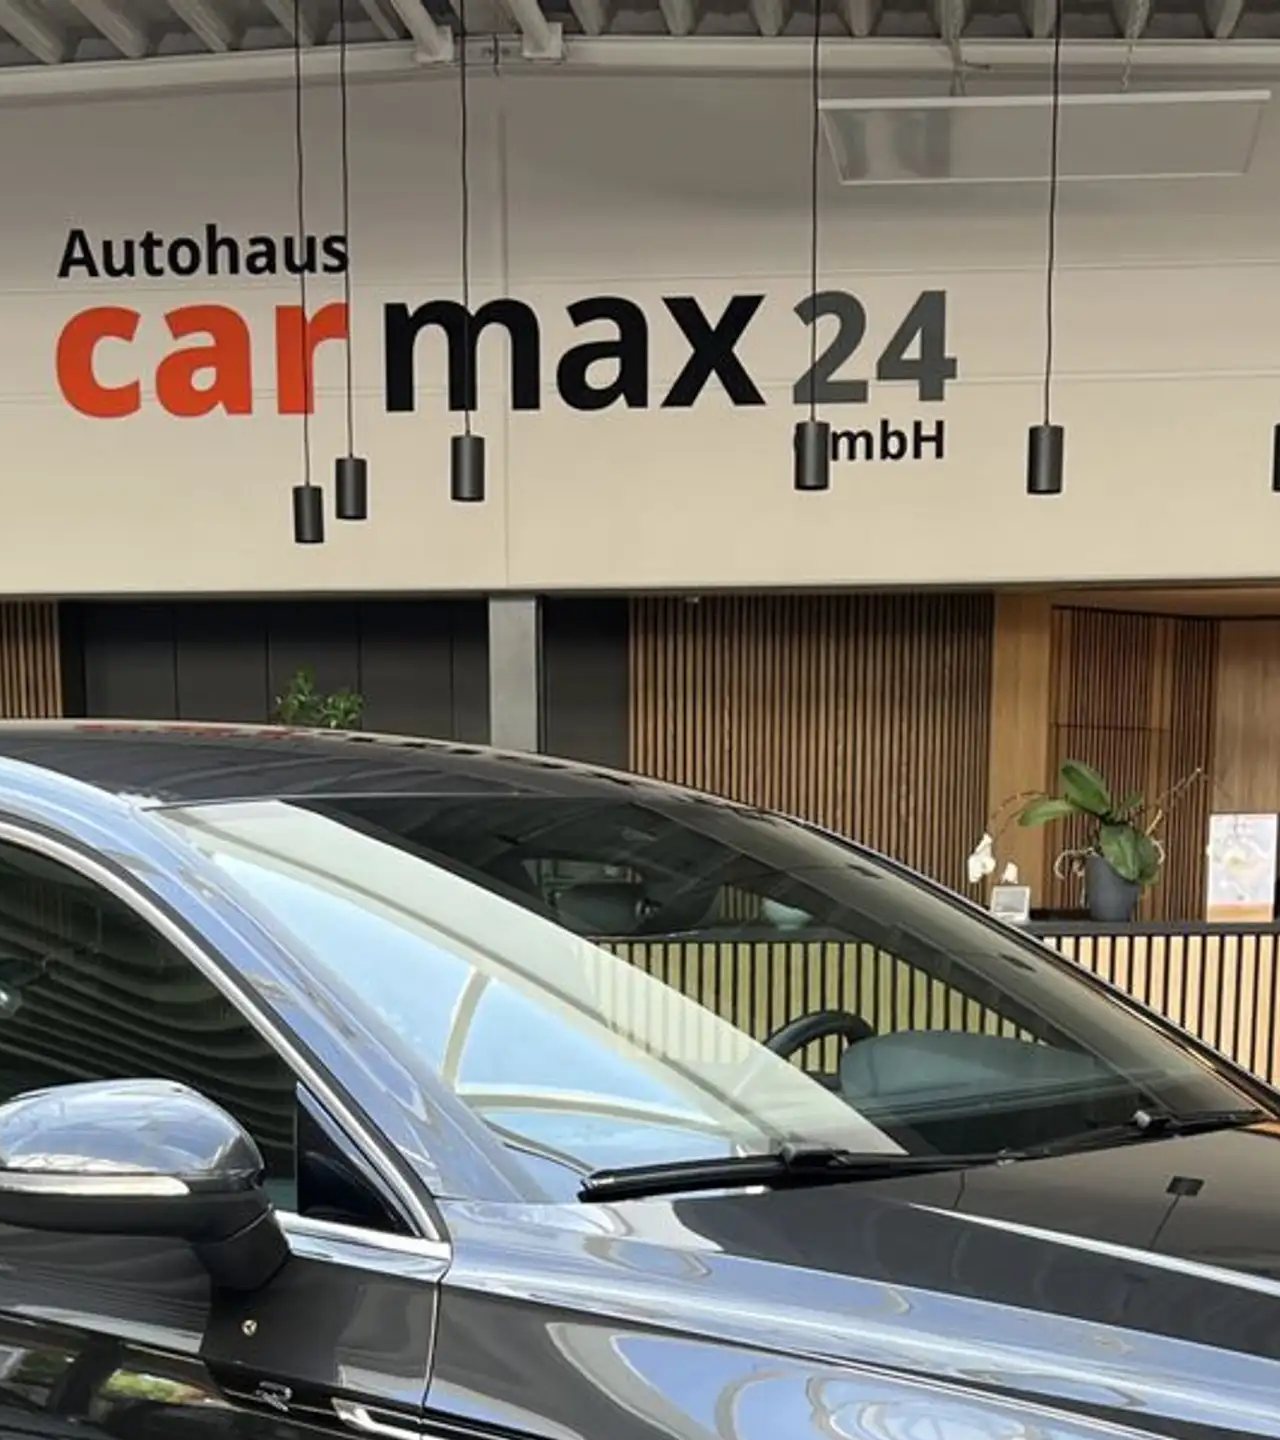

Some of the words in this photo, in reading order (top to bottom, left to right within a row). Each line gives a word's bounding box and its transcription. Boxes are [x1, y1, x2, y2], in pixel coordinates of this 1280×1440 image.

[58, 224, 349, 277] Autohaus
[54, 300, 349, 419] car
[382, 291, 766, 413] max
[792, 288, 958, 406] 24
[794, 418, 945, 462] mbH
